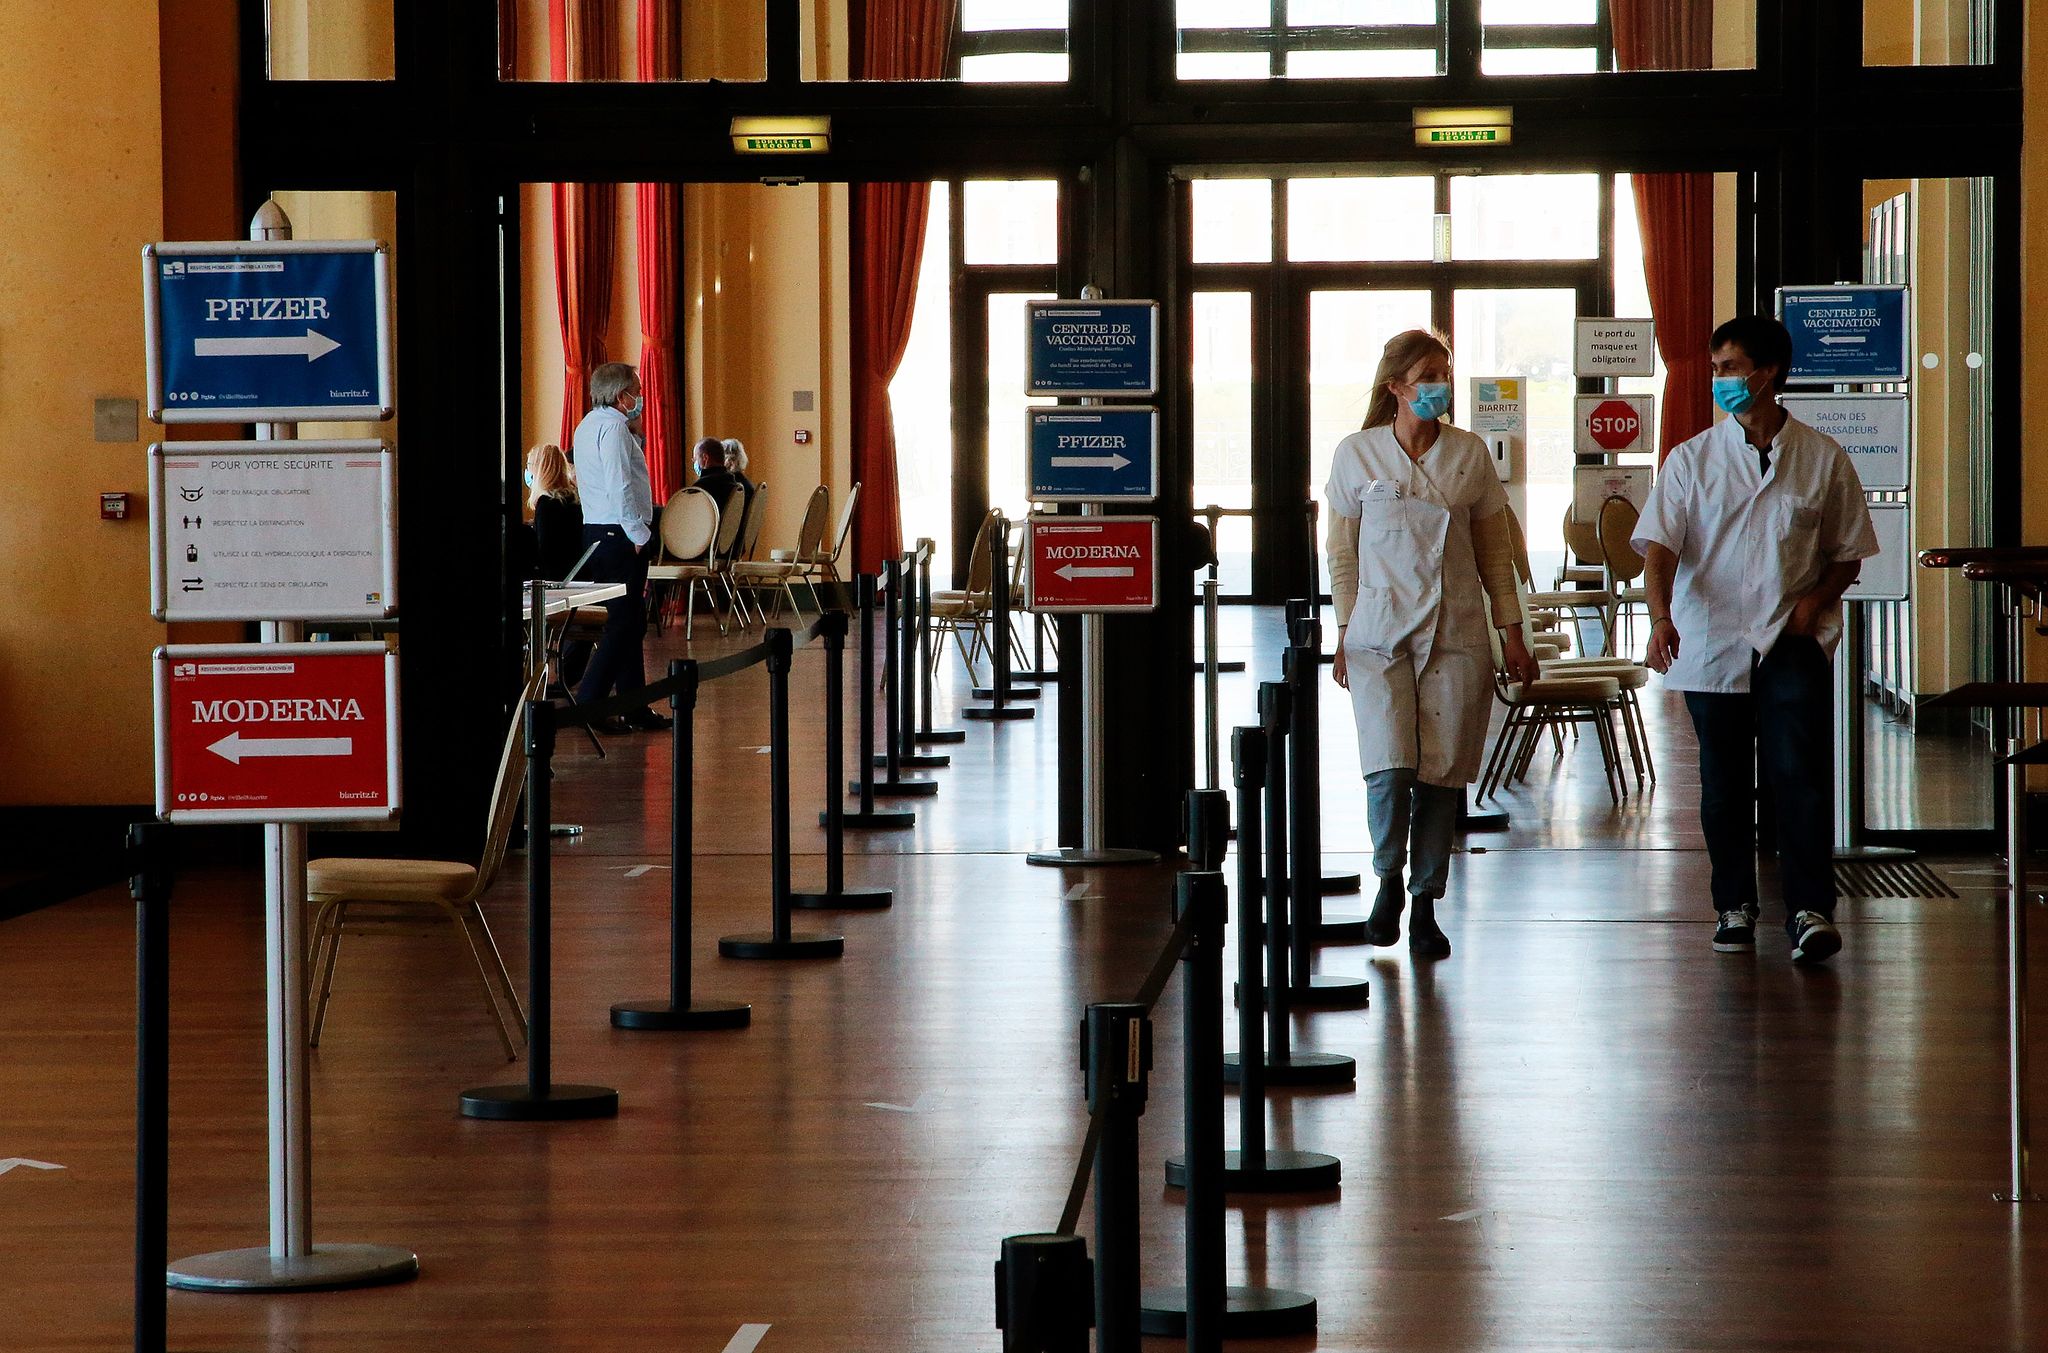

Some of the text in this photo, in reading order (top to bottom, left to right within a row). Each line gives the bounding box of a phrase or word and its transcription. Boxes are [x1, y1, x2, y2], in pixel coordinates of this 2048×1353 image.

[206, 298, 330, 321] PFIZER
[1808, 309, 1876, 318] CENTRE DE
[1803, 318, 1881, 328] VACCINATION
[1052, 324, 1130, 334] CENTRE DE
[1605, 330, 1622, 339] port
[1046, 335, 1136, 345] VACCINATION
[1591, 343, 1623, 351] masque
[1592, 356, 1636, 364] obligatoire
[330, 390, 370, 398] biarritz.fr
[1478, 404, 1518, 412] BIARRITZ
[1816, 412, 1866, 420] SALON DES
[1592, 418, 1637, 433] STOP
[1816, 426, 1878, 434] BASSADEURS
[1058, 436, 1126, 449] PFIZER
[1841, 445, 1898, 454] ACCINATION
[211, 460, 333, 469] POUR VOTRE SECURITE
[1046, 546, 1140, 559] MODERNA
[192, 699, 364, 723] MODERNA
[340, 791, 378, 799] biarritz.fr
